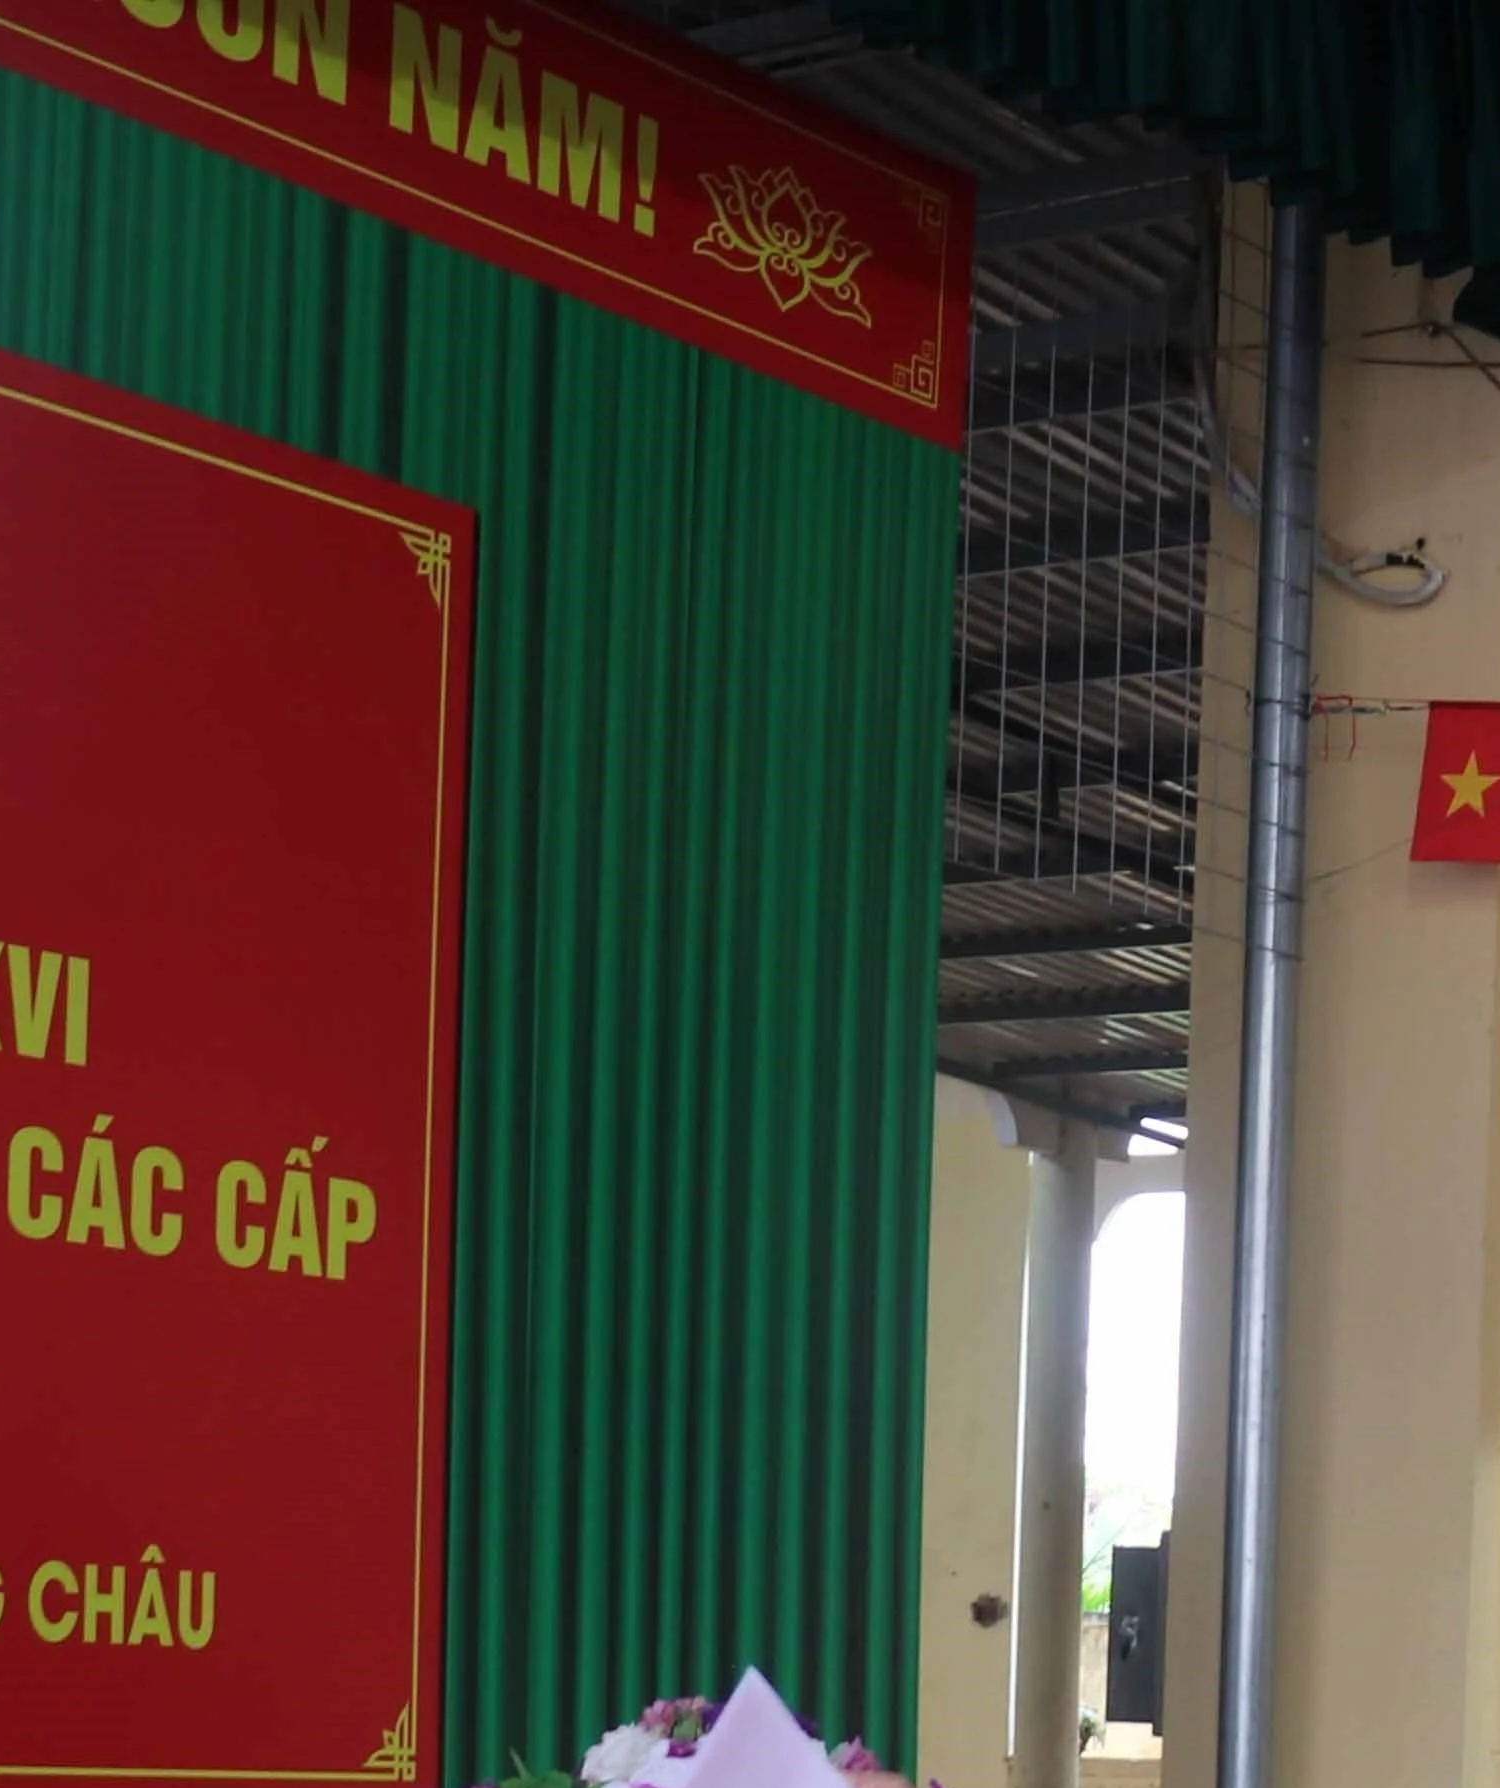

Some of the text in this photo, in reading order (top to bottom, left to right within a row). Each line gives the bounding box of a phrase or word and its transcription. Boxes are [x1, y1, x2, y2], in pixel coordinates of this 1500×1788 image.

[389, 2, 659, 238] NĂM!
[7, 1113, 184, 1256] CÁC
[215, 1136, 377, 1280] CẤP
[28, 1545, 216, 1649] CHÂU
